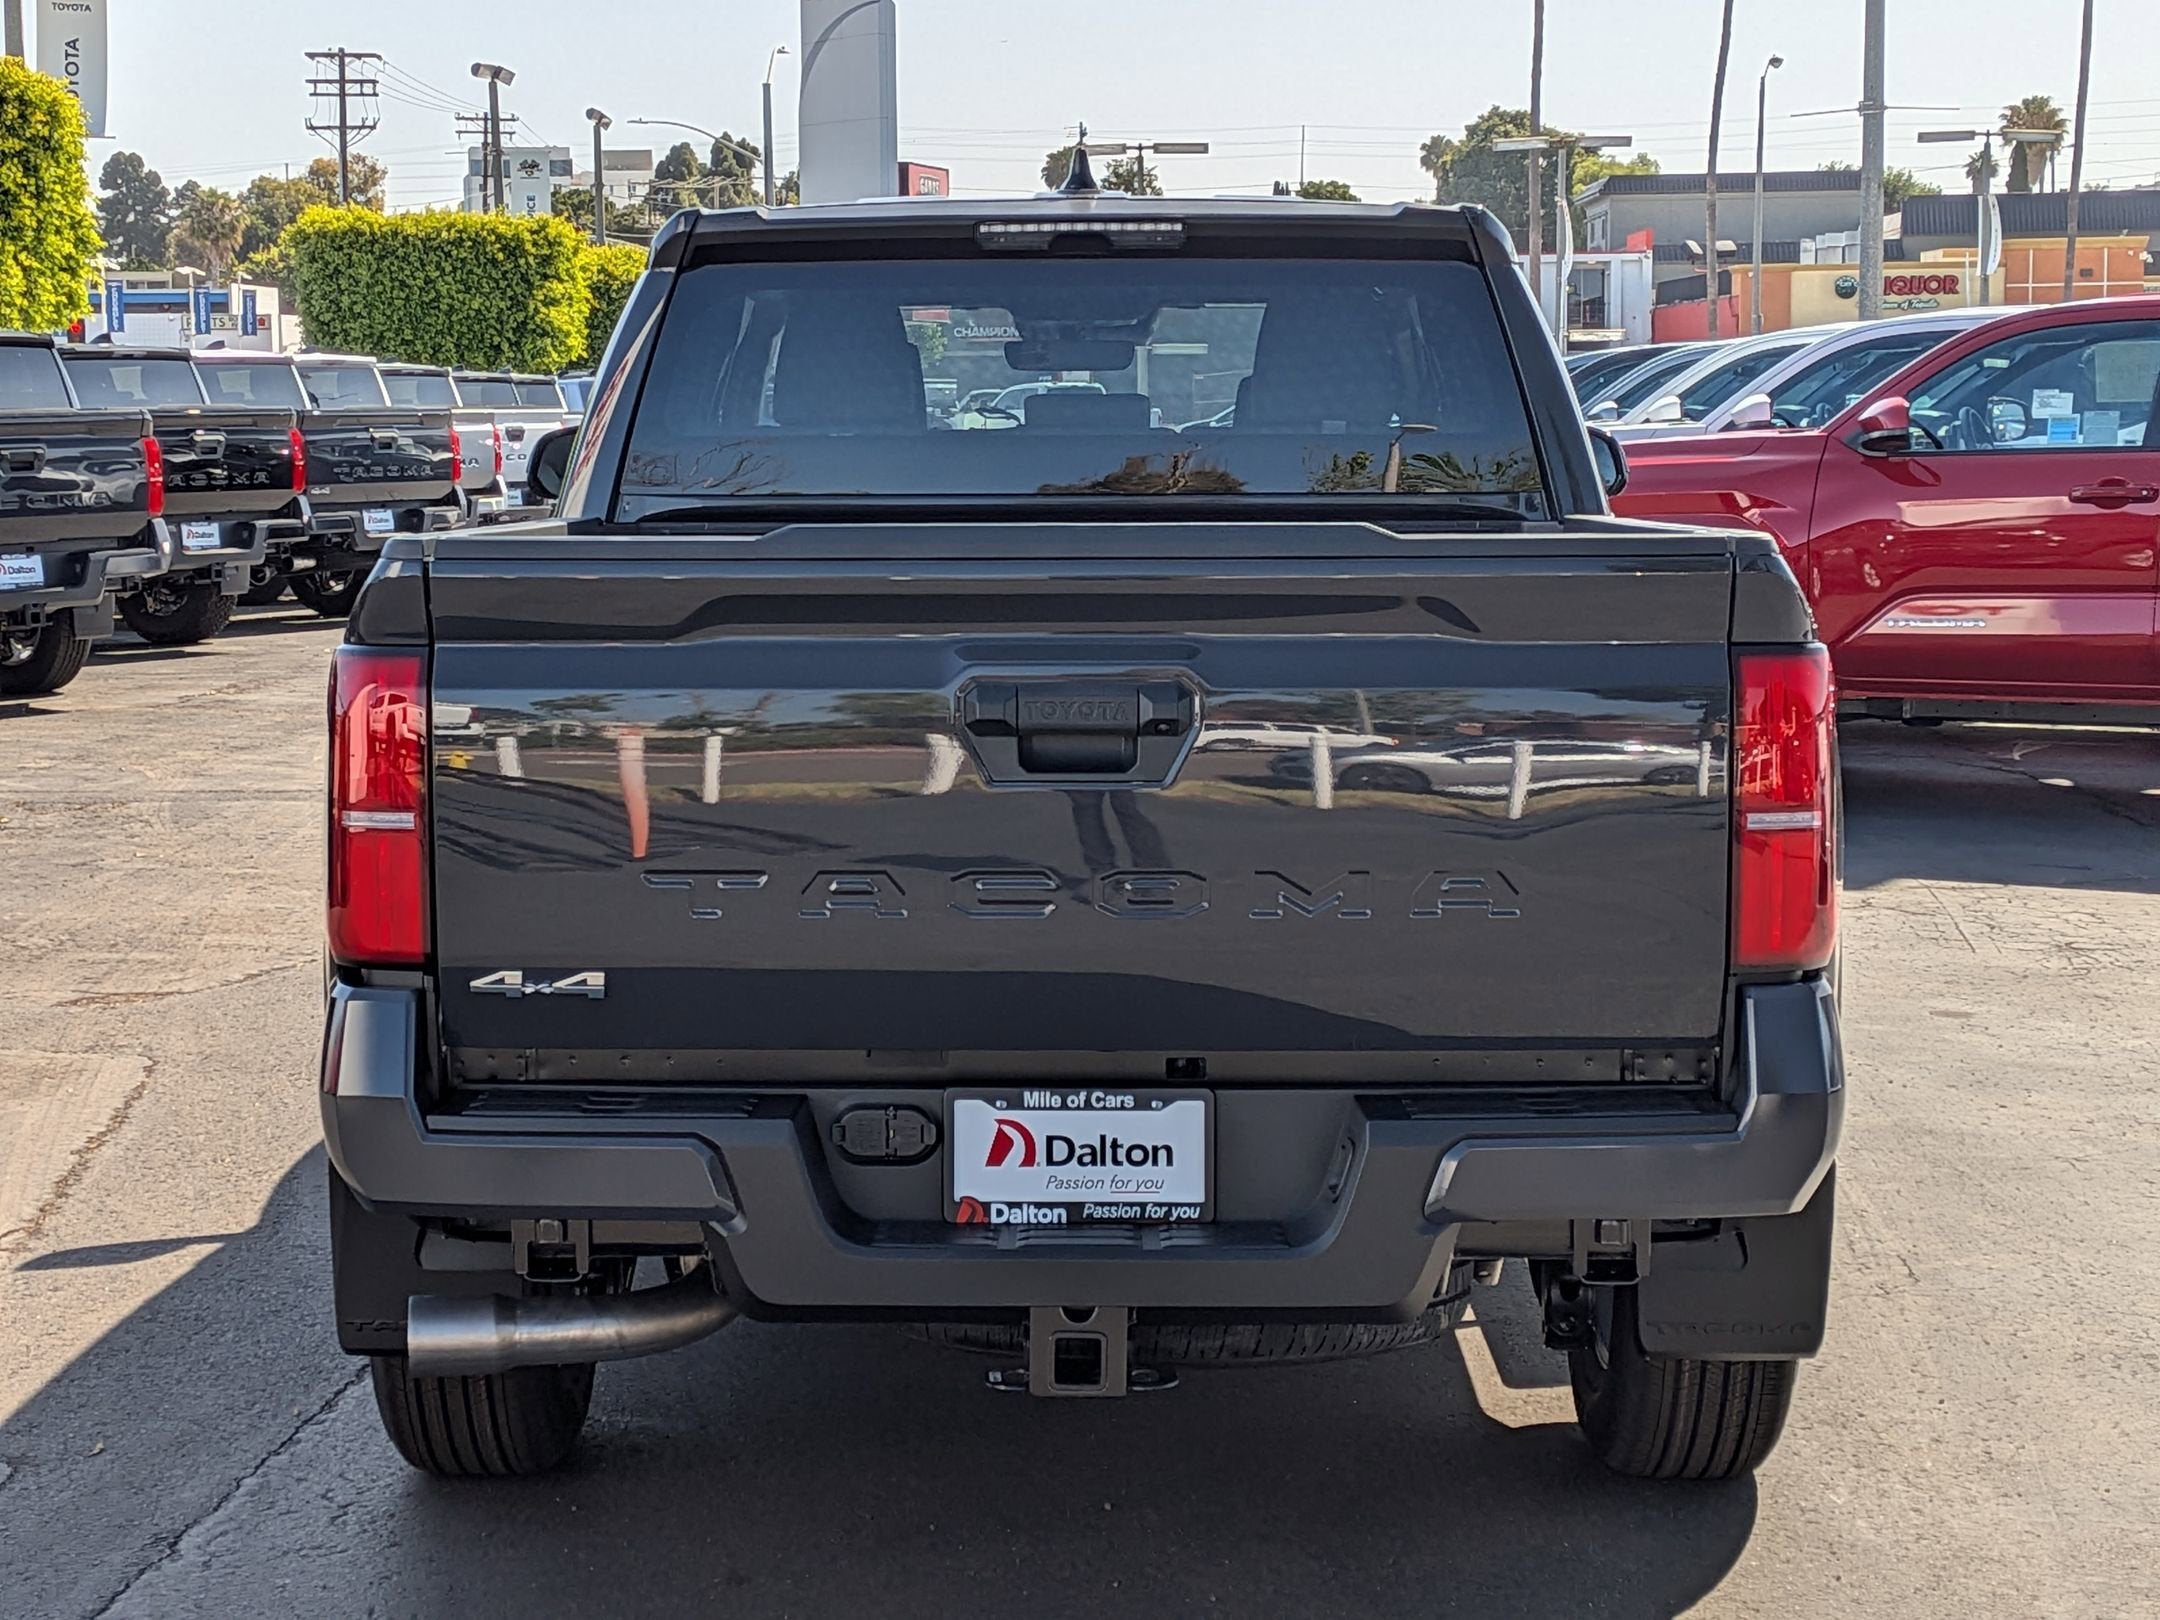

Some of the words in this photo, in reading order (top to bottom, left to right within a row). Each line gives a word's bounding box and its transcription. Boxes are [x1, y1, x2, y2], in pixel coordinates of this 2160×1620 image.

[52, 2, 92, 12] TOYOTA
[1883, 274, 1960, 295] IQUOR
[953, 327, 1019, 337] CHAMPION
[1024, 701, 1130, 722] TOYOTA
[640, 869, 1521, 919] TACOMA
[1023, 1091, 1061, 1108] Mile
[1066, 1091, 1087, 1108] of
[1090, 1091, 1135, 1109] Cars
[1045, 1134, 1174, 1168] Dalton
[1045, 1175, 1104, 1190] Passion
[1110, 1175, 1132, 1190] for
[1136, 1178, 1165, 1193] you
[990, 1203, 1067, 1225] Dalton
[1082, 1203, 1140, 1219] Passion
[1144, 1203, 1169, 1219] for
[1169, 1205, 1200, 1221] you
